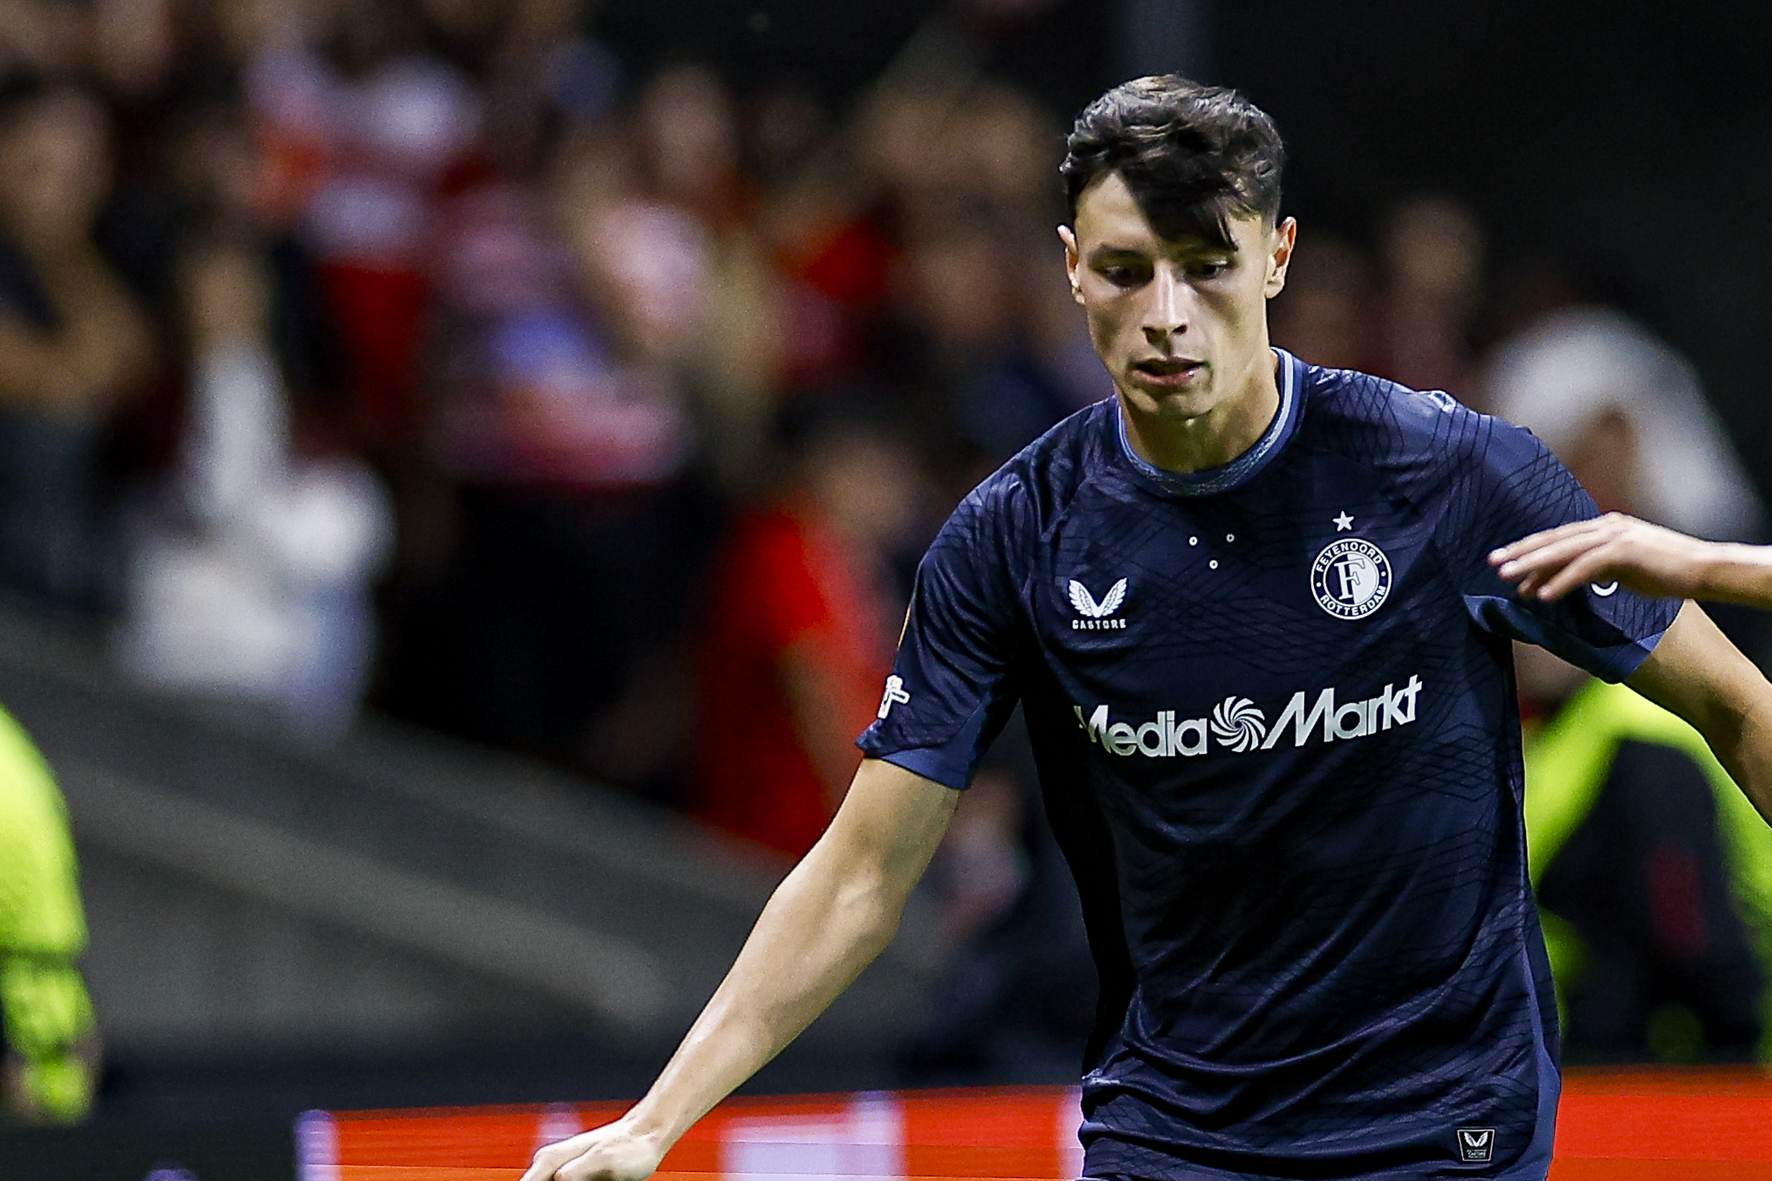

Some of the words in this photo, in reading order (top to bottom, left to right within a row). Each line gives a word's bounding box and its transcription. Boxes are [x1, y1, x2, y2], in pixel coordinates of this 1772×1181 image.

[1316, 541, 1382, 573] FEYENOORD
[1320, 585, 1387, 616] ROTTERDAM
[1072, 618, 1126, 630] CASTORE
[1260, 674, 1423, 750] Markt
